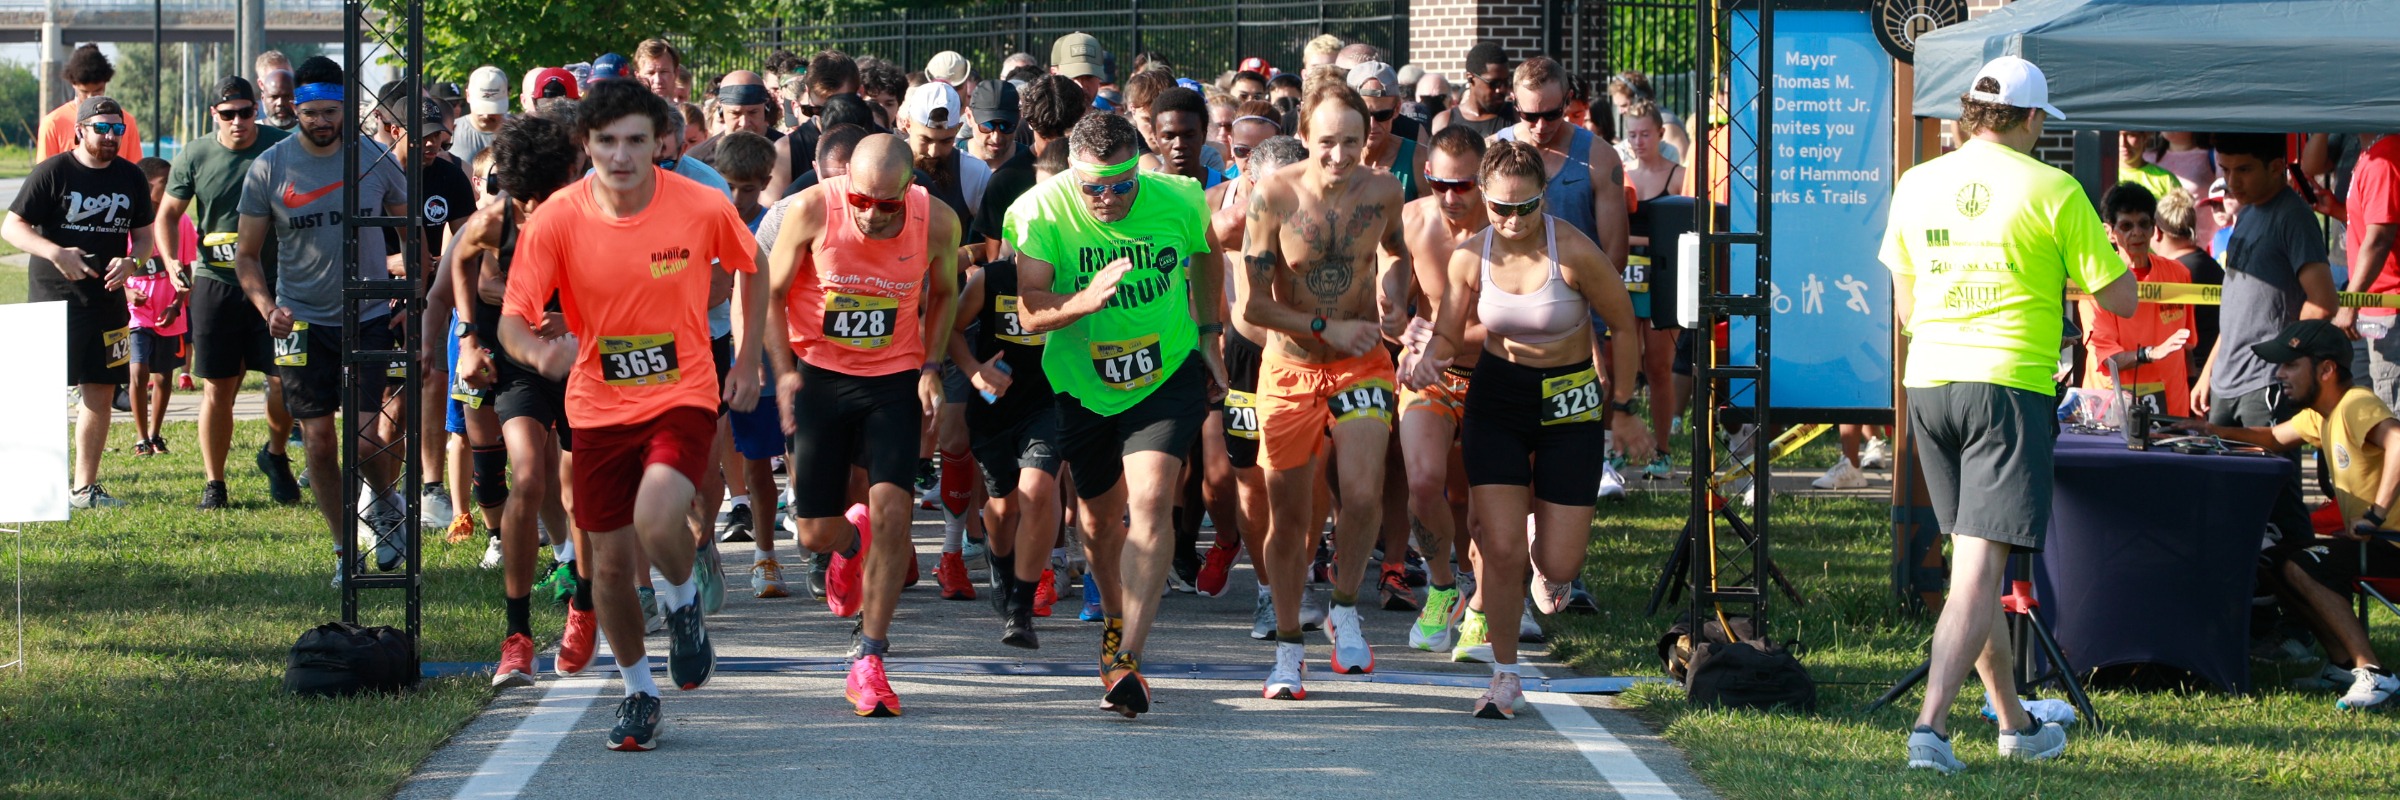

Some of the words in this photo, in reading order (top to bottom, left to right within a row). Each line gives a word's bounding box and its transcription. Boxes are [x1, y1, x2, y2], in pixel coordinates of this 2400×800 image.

[1786, 51, 1836, 70] Mayor
[1836, 75, 1854, 89] M.
[1751, 97, 1841, 111] MDermott
[1848, 98, 1870, 112] Jr.
[1772, 120, 1820, 135] nvites
[1825, 124, 1854, 139] you
[1779, 143, 1795, 157] to
[1800, 143, 1842, 162] enjoy
[1780, 166, 1795, 180] of
[1800, 166, 1879, 181] Hammond
[1804, 189, 1815, 204] &
[1822, 189, 1867, 205] Trails
[66, 191, 130, 223] Loop
[289, 212, 323, 230] JUST
[329, 210, 343, 226] D
[212, 242, 238, 262] 49
[826, 270, 861, 284] South
[1620, 265, 1645, 283] 15
[1949, 286, 1998, 300] SMITH
[834, 310, 885, 337] 428
[112, 334, 131, 360] 42
[610, 346, 668, 379] 365
[1105, 348, 1154, 382] 476
[1338, 386, 1386, 413] 194
[1552, 382, 1600, 418] 328
